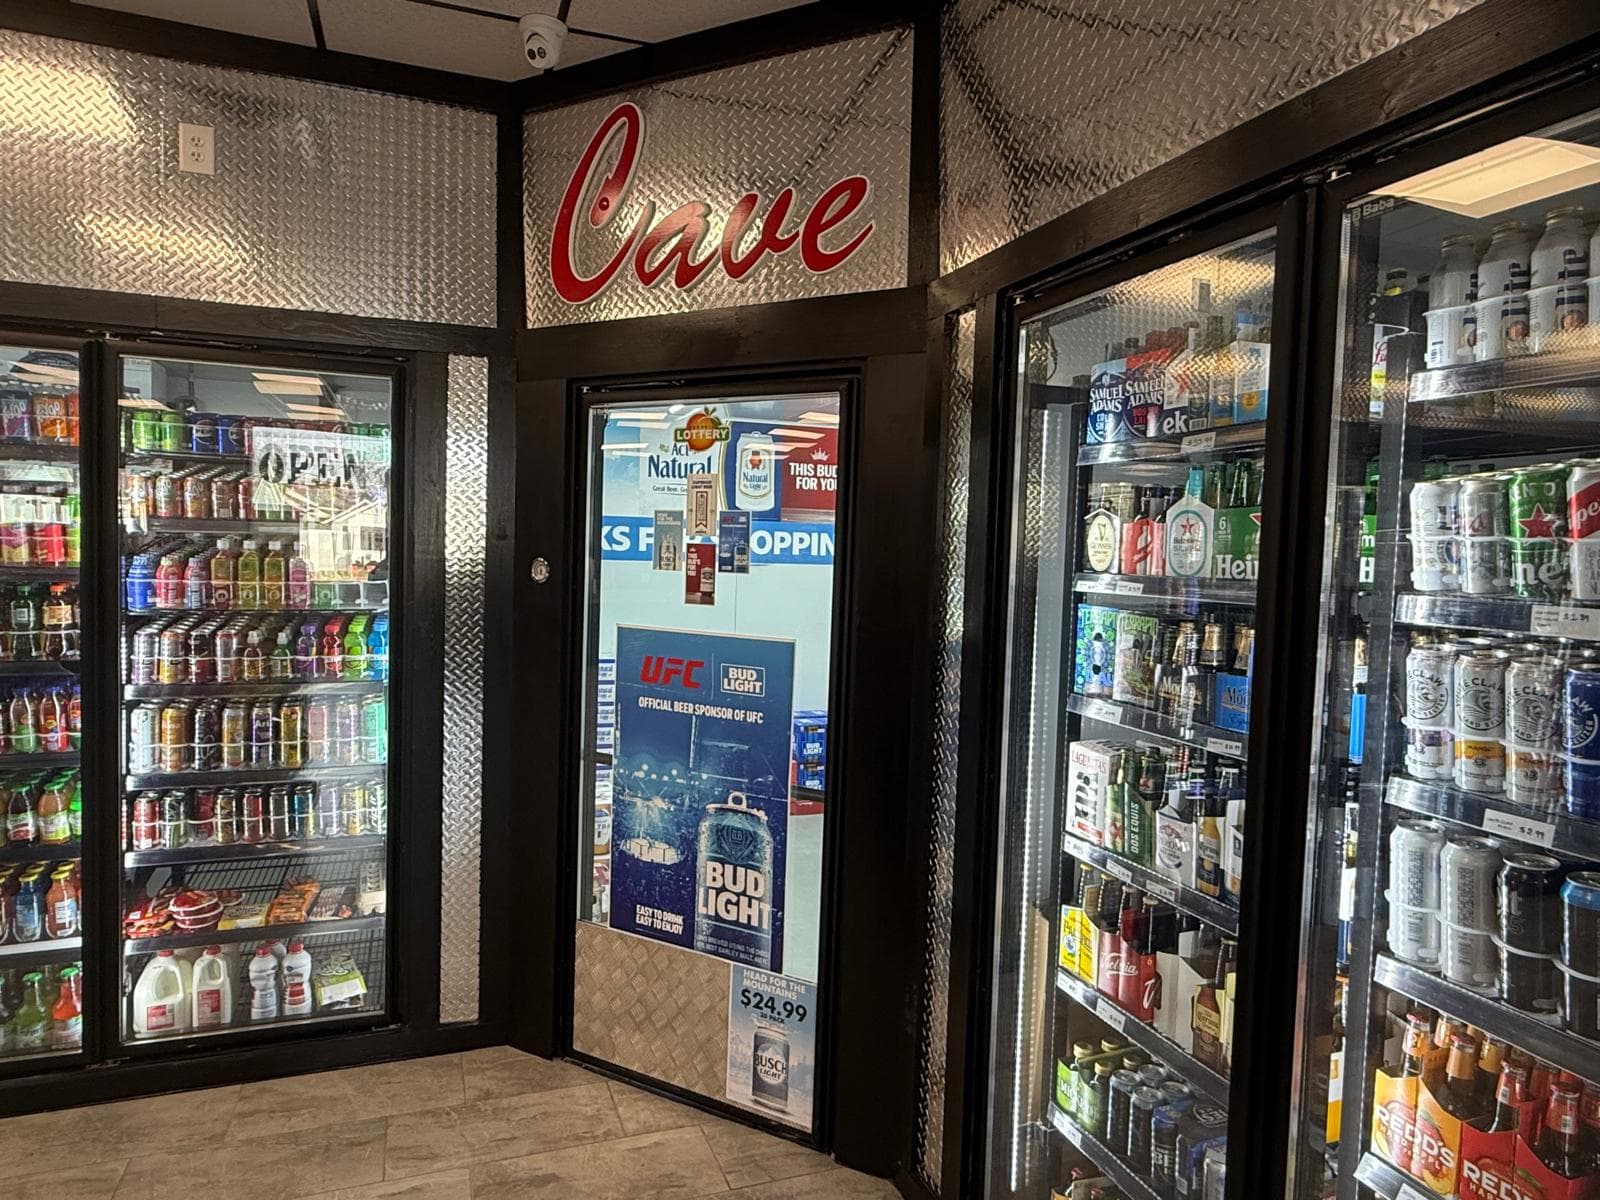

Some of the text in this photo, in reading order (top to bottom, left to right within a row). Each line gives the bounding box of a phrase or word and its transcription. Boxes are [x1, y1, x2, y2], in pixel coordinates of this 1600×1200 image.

[551, 102, 874, 305] Cave
[1090, 384, 1124, 402] SAMUEL
[1091, 399, 1121, 415] ADAMS
[676, 428, 728, 440] LOTTERY
[648, 454, 712, 479] Natural
[743, 472, 768, 483] Natural
[789, 462, 814, 476] THIS
[796, 476, 817, 491] FOR
[641, 655, 704, 689] UFC
[728, 667, 757, 681] BUD
[724, 678, 763, 693] LIGHT
[638, 696, 764, 724] OFFICIAL BEER SPONSOR OF UFC
[1131, 801, 1139, 854] DOS EQUIS
[706, 860, 766, 898] BUD
[636, 904, 684, 925] EASY TO DRINK
[697, 889, 770, 930] LIGHT
[636, 913, 653, 927] EASY
[653, 918, 662, 930] TO
[662, 920, 683, 935] ENJOY
[743, 969, 806, 993] HEAD FOR THE
[743, 978, 797, 1000] MOUNTAINS
[740, 987, 808, 1023] $24.99
[768, 1015, 785, 1024] PACK
[754, 1053, 787, 1075] BUSCH
[760, 1067, 781, 1080] LIGHT
[1375, 1104, 1456, 1169] REDD'S
